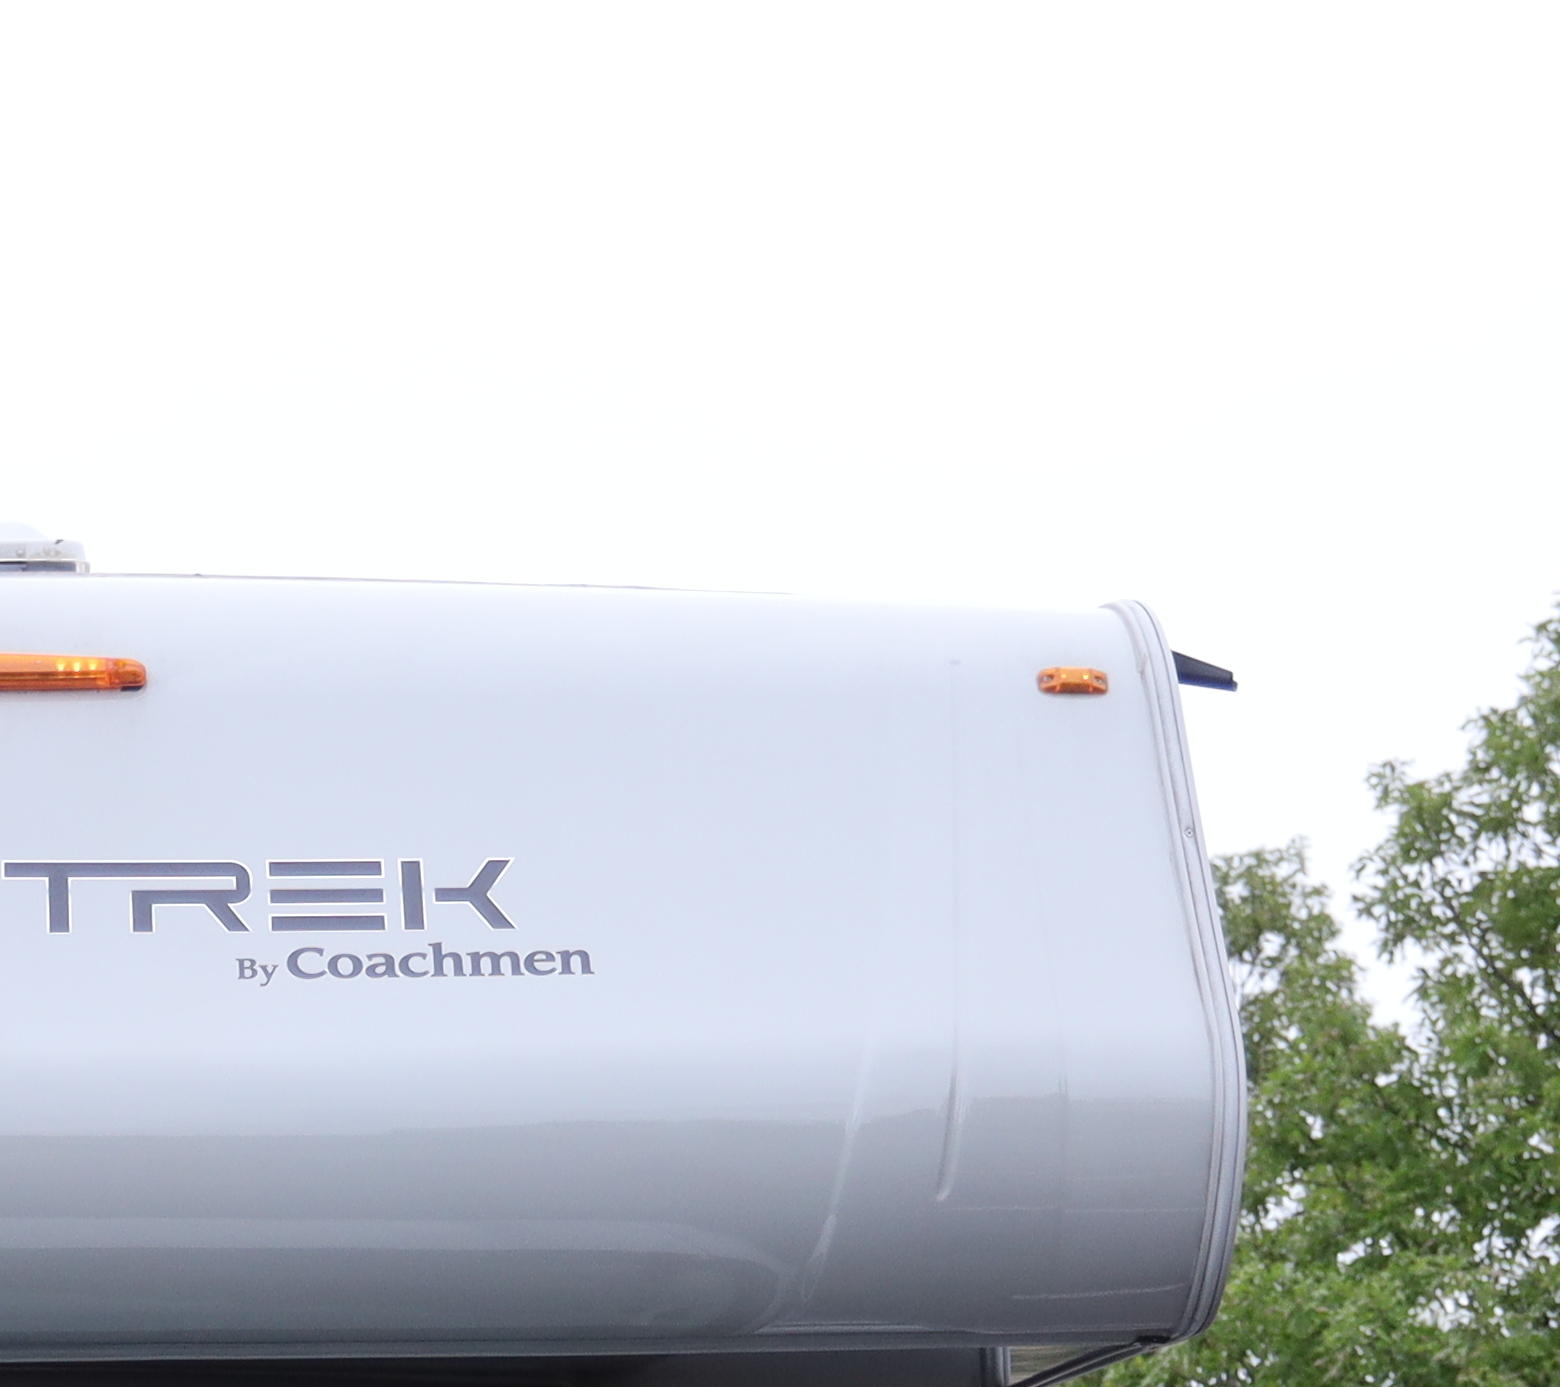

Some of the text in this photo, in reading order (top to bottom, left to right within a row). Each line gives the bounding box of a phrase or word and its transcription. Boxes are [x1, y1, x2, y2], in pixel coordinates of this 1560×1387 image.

[2, 858, 517, 934] TREK
[235, 941, 595, 987] By Coachmen
